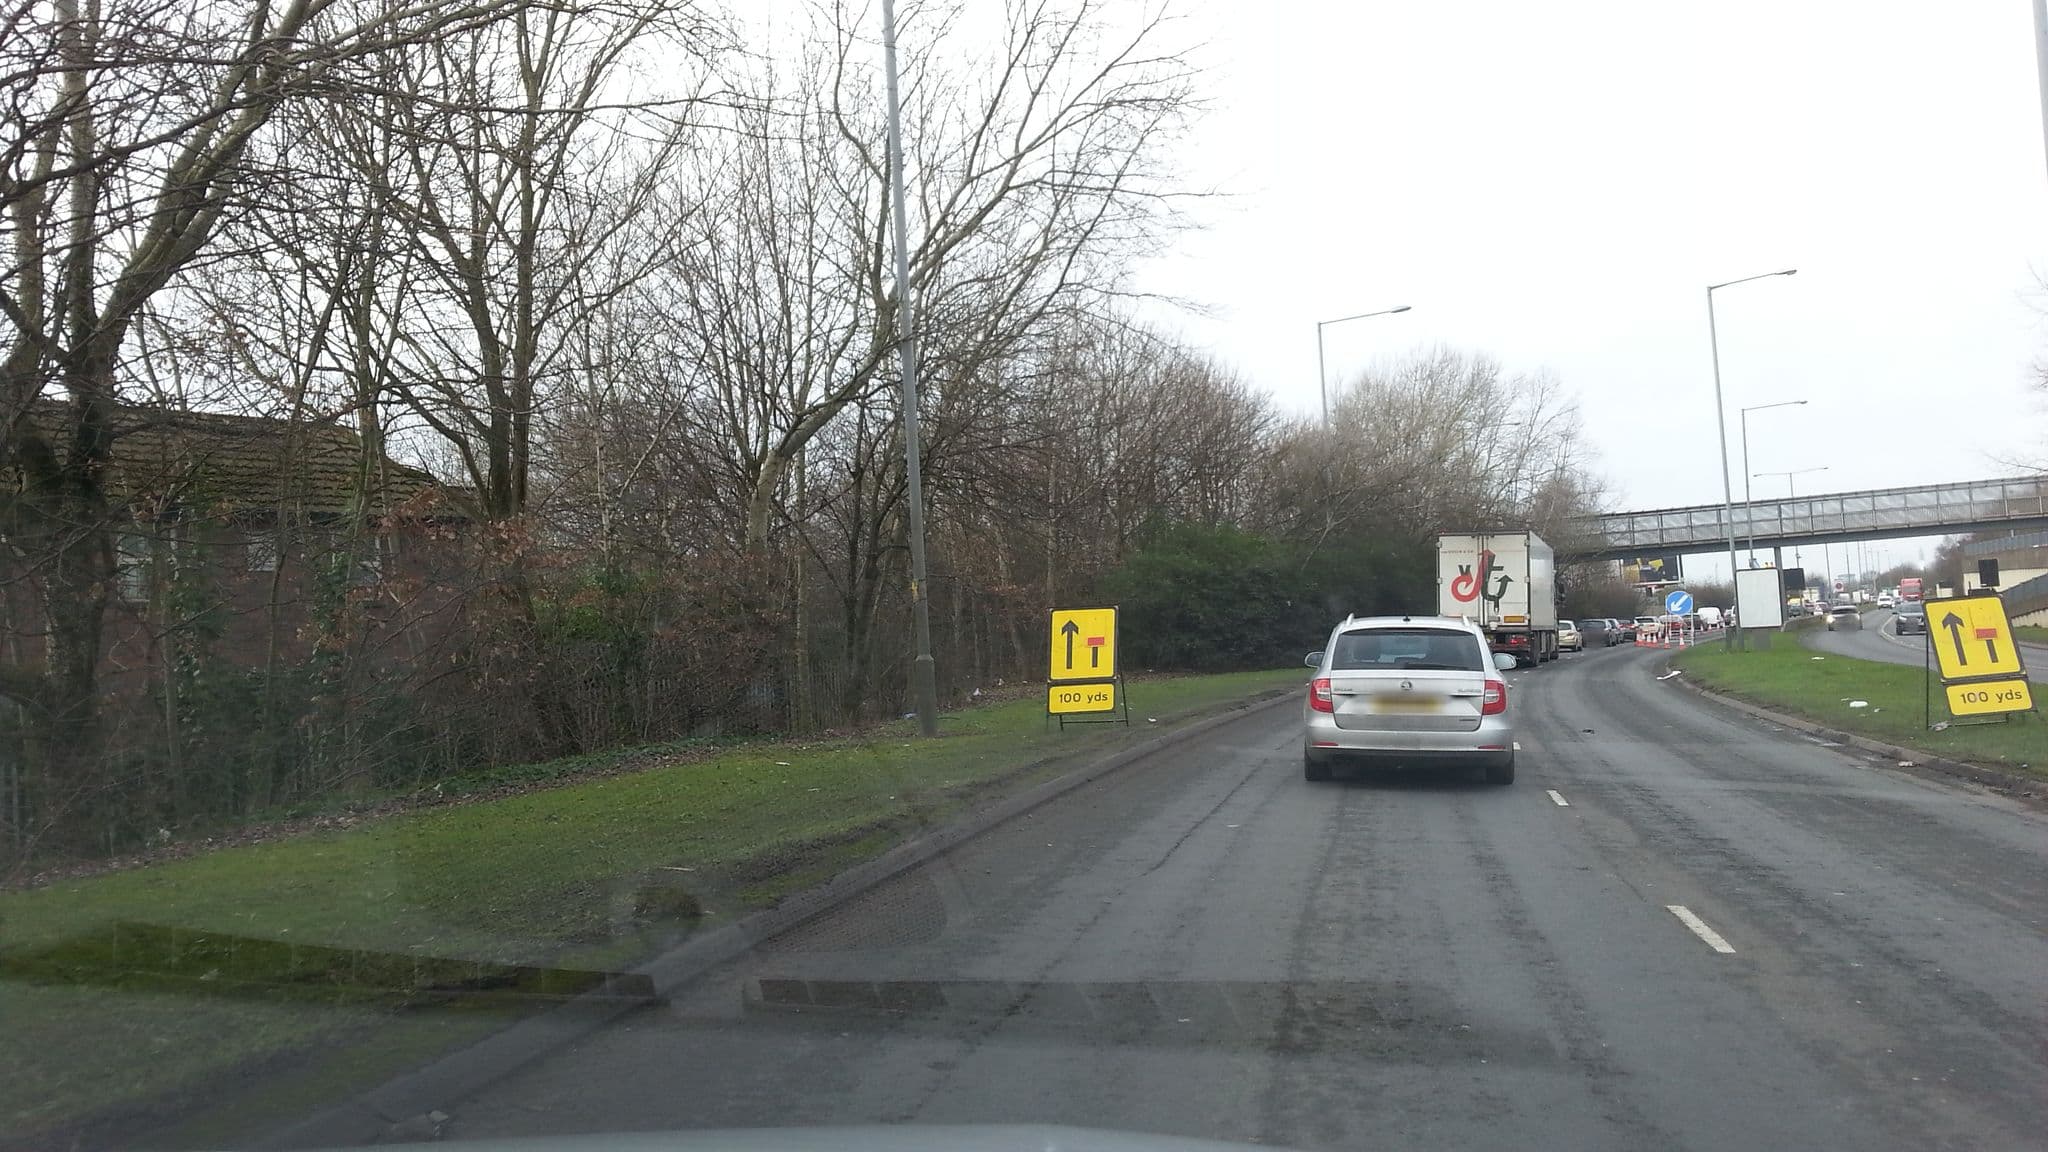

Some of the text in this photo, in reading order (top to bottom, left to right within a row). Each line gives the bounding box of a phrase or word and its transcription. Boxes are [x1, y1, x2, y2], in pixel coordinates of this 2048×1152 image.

[1059, 691, 1108, 704] 100 yds
[1960, 689, 2022, 704] 100 yds
